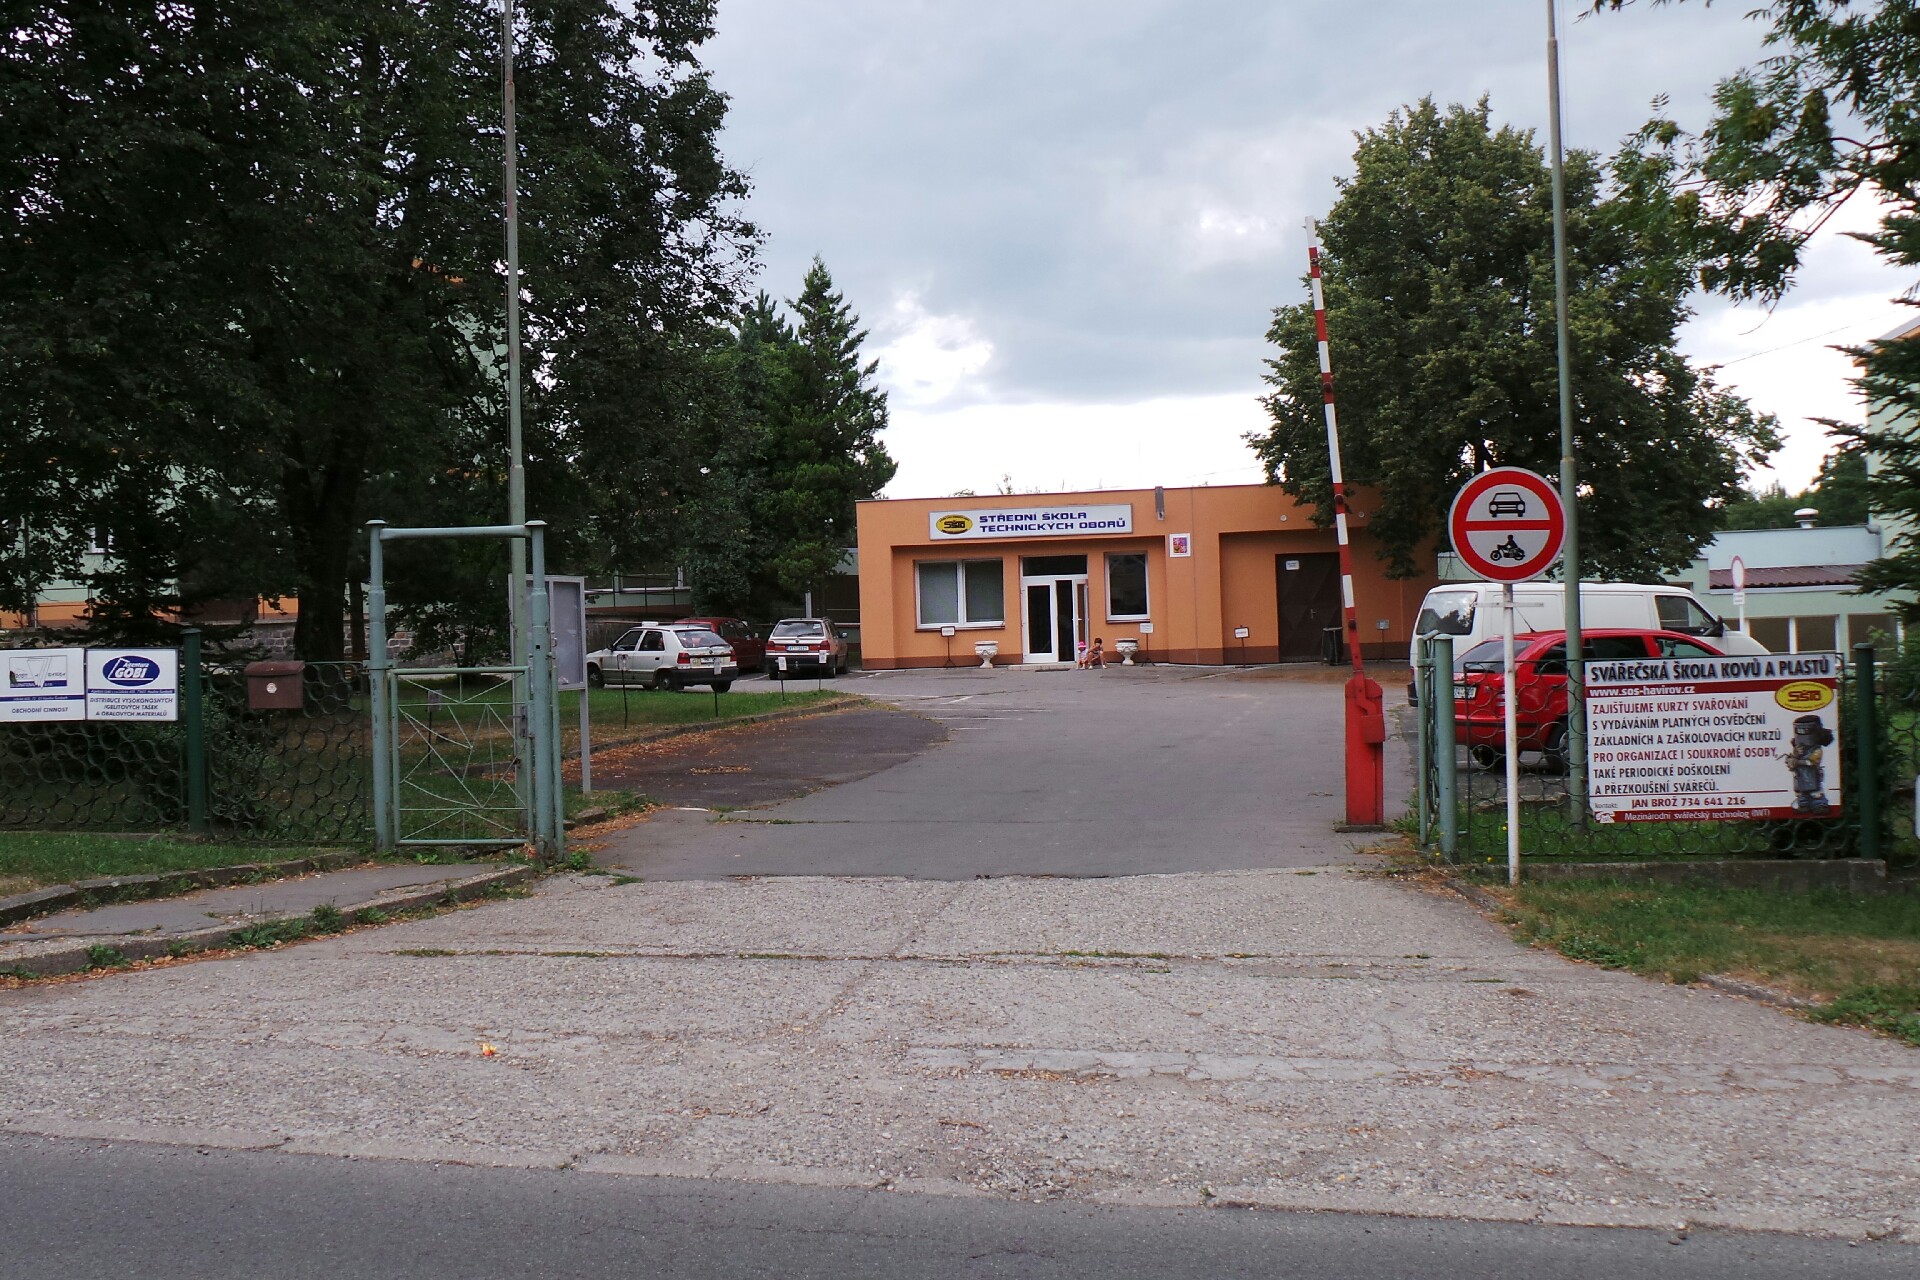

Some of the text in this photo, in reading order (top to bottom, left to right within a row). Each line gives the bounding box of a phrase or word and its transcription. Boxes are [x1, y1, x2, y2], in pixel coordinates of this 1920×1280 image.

[979, 512, 1037, 523] STŘEDNÍ
[1041, 511, 1087, 521] ŠKOLA
[979, 521, 1074, 533] TECHNICKÝCH
[1079, 517, 1126, 529] OBORŮ
[114, 667, 148, 678] GOBI
[1590, 655, 1831, 682] SVÁŘEČSKÁ ŠKOLA KOVŮ A PLASTŮ
[1589, 685, 1696, 697] www.sos-havirov.cz
[1592, 697, 1749, 714] ZAJIŠŤUJEME KURZY SVAŘOVÁNÍ
[1592, 712, 1766, 730] S VYDÁVÁNÍM PLATNÝCH OSVĚDČENÍ
[1594, 728, 1781, 747] ZÁKLADNÍCH A ZAŠKOLOVACÍCH KURZŮ
[1594, 745, 1779, 762] PRO ORGANIZACE I SOUKROMÉ OSOBY,
[1594, 762, 1731, 779] TAKÉ PERIODICKÉ DOŠKOLENÍ
[1595, 784, 1601, 794] A
[1604, 780, 1670, 794] PŘEZKOUŠENÍ
[1631, 796, 1746, 809] JAN BROŽ 734 641 216
[1624, 812, 1671, 821] Mezinárodní
[1712, 810, 1749, 819] technolog
